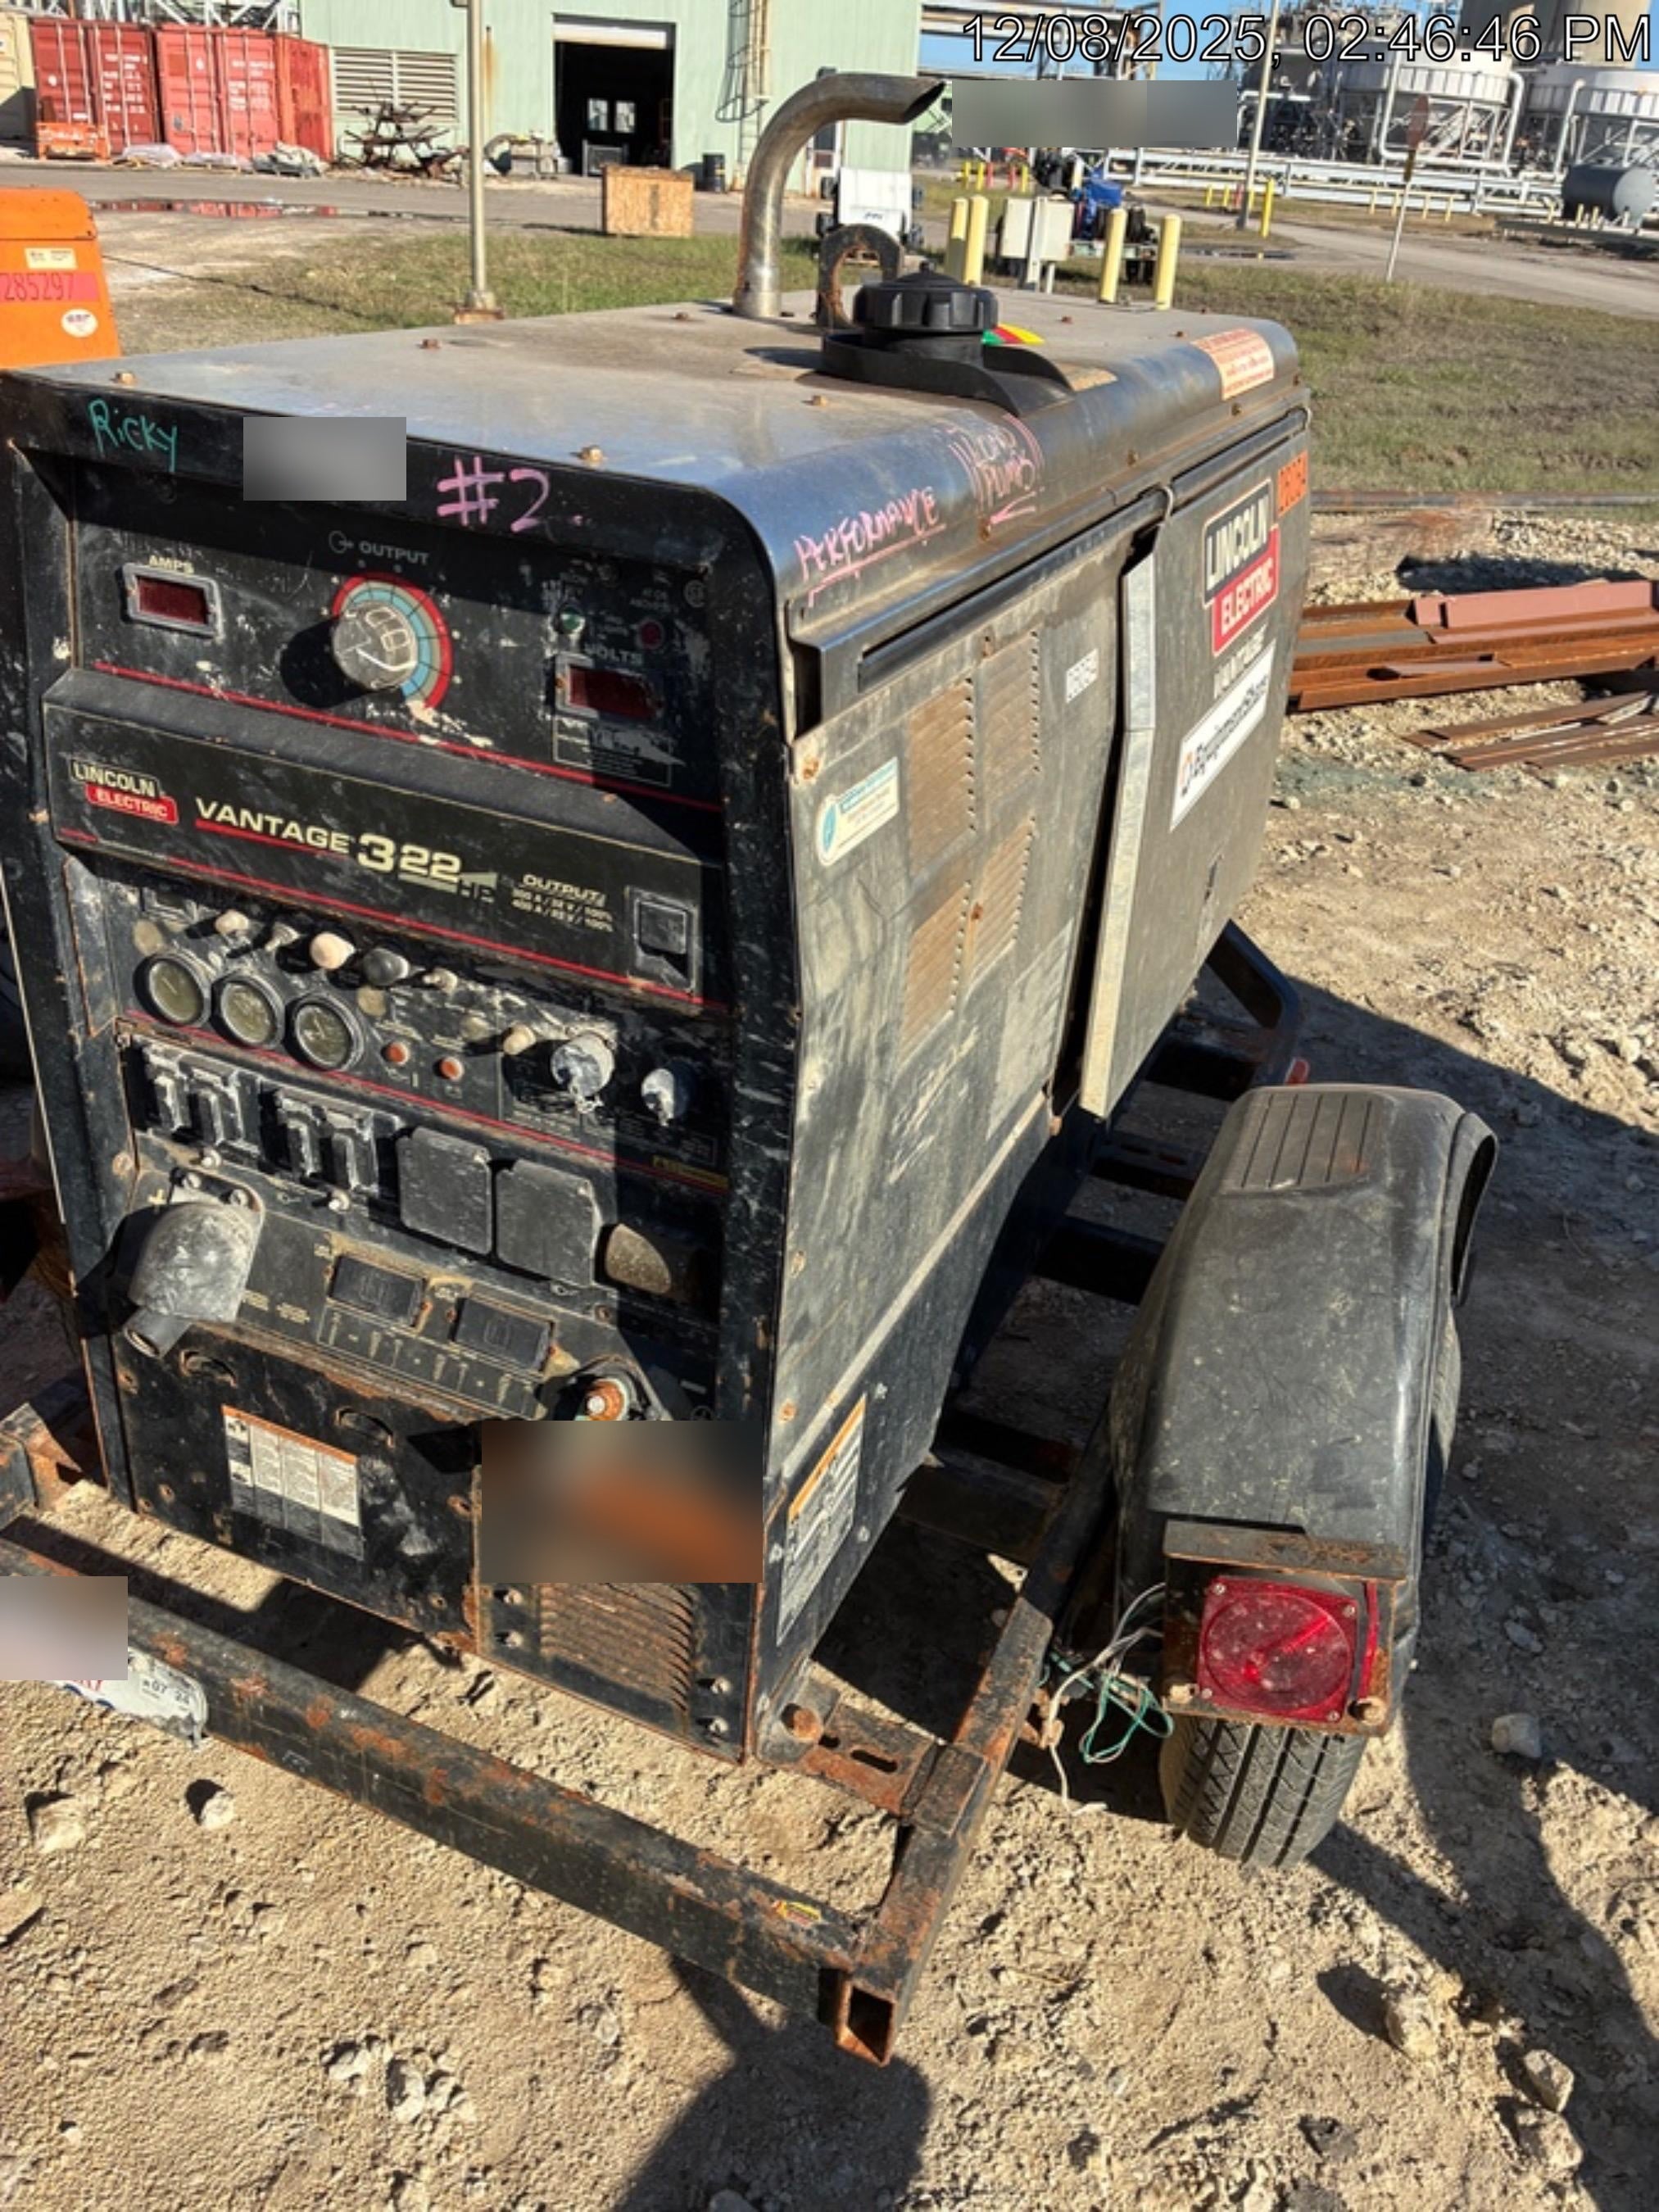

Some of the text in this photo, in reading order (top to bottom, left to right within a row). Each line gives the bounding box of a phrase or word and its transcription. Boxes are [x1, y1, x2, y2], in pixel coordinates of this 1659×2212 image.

[0, 272, 75, 301] 285297
[437, 456, 550, 533] #2
[360, 540, 430, 565] OUTPUT
[1206, 494, 1270, 592] LINCOLN
[149, 555, 195, 576] AMPS
[1221, 556, 1274, 637] ELECTRIC
[73, 761, 156, 799] LINCOLN
[96, 788, 169, 818] ELECTRIC
[195, 796, 462, 885] VANTAGE 322
